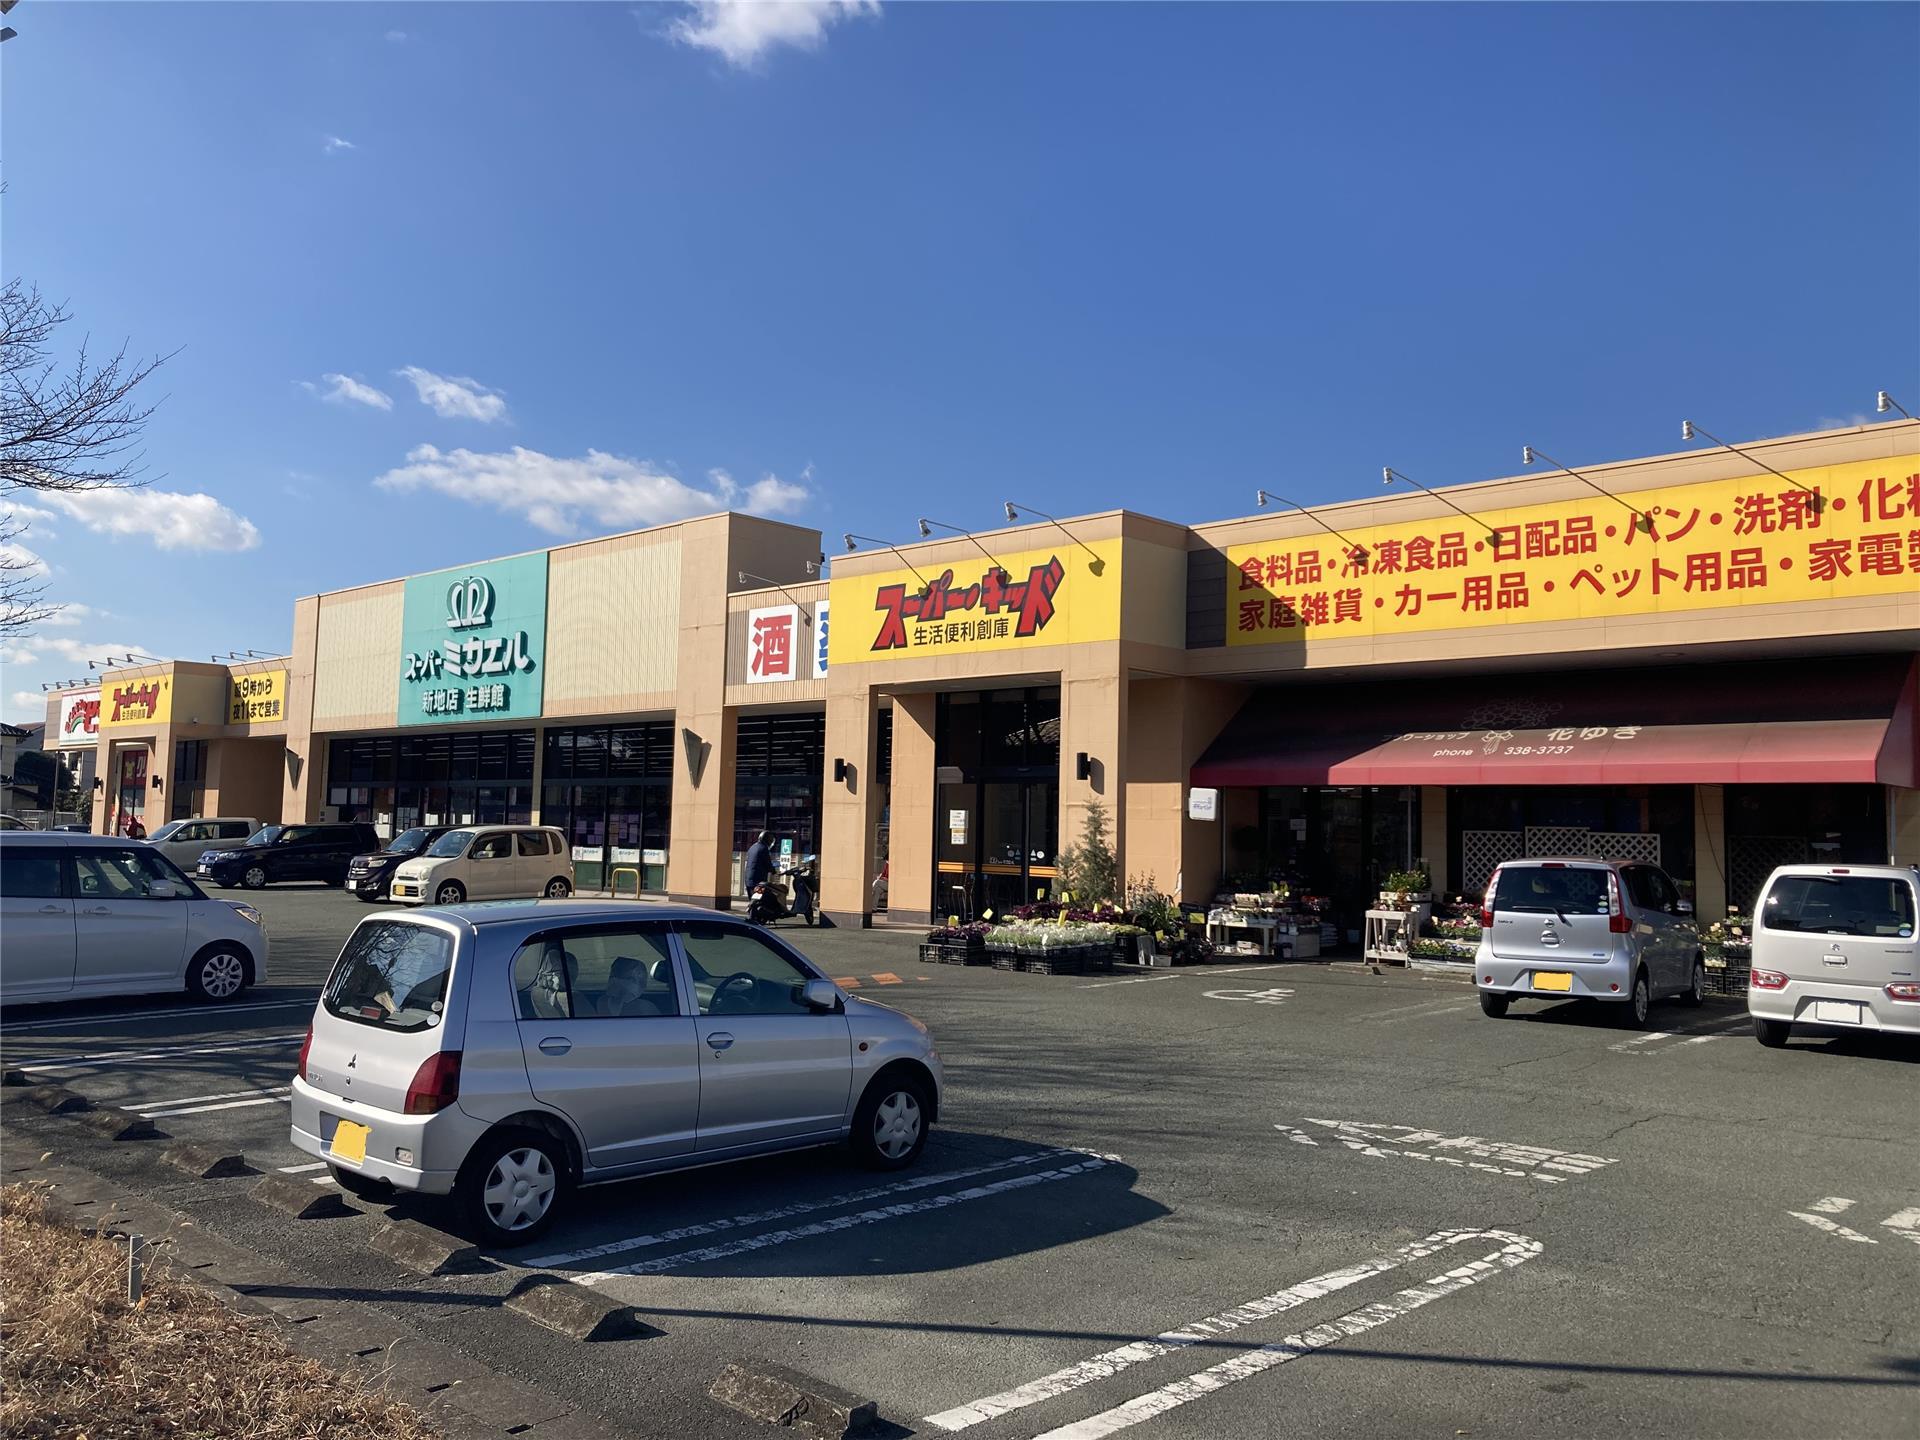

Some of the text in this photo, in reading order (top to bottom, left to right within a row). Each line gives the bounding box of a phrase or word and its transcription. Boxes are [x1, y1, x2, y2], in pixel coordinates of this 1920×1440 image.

[751, 614, 793, 676] 酒
[913, 617, 1009, 646] 生活便利創庫
[422, 683, 506, 713] 新地店 生鮮館
[1432, 745, 1574, 757] phone 338-3737
